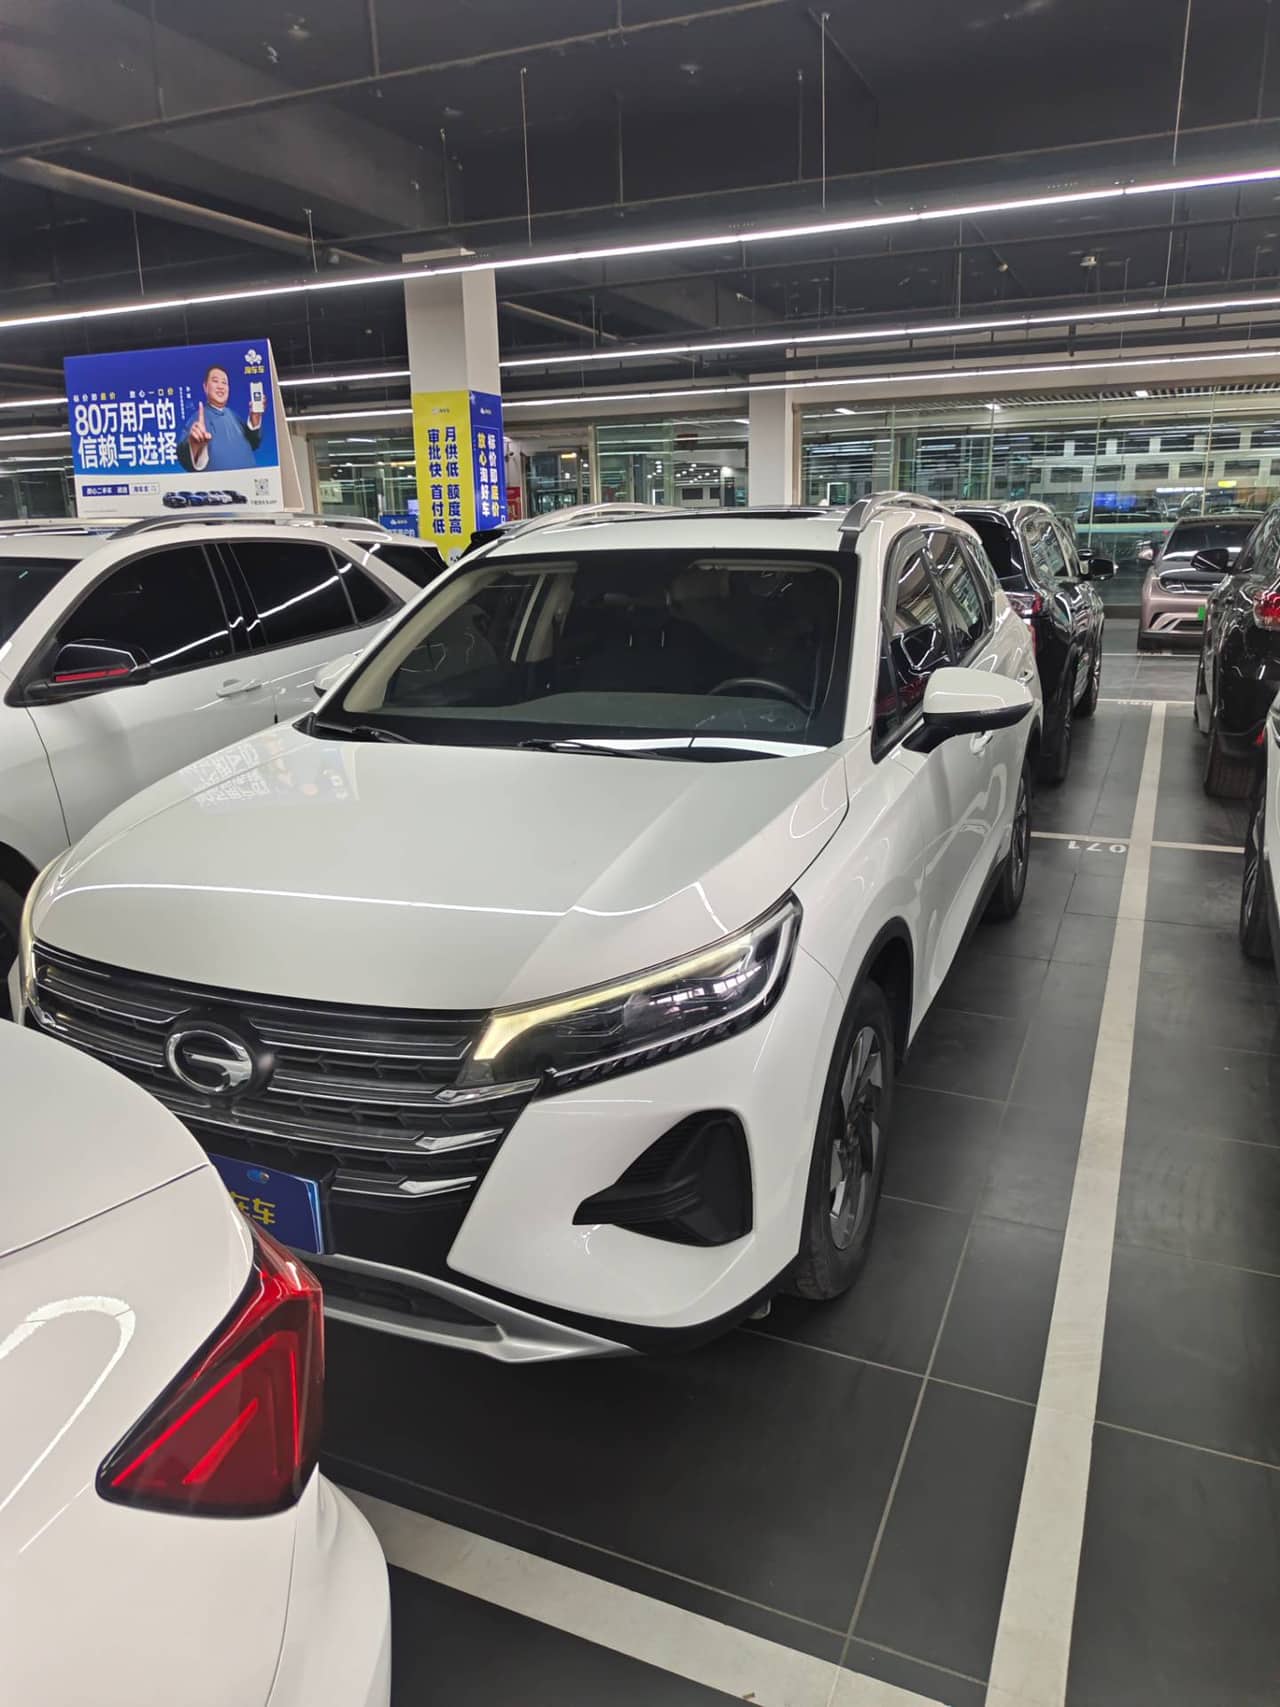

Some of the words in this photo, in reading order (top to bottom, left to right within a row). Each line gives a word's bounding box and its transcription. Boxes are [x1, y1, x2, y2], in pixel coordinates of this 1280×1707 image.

[74, 398, 176, 436] 80万用户的
[78, 432, 178, 469] 信赖与选择
[427, 428, 443, 478] 审批快
[445, 426, 460, 478] 月供低
[430, 485, 445, 534] 首付低
[448, 484, 462, 534] 额度高
[1067, 840, 1127, 853] 071
